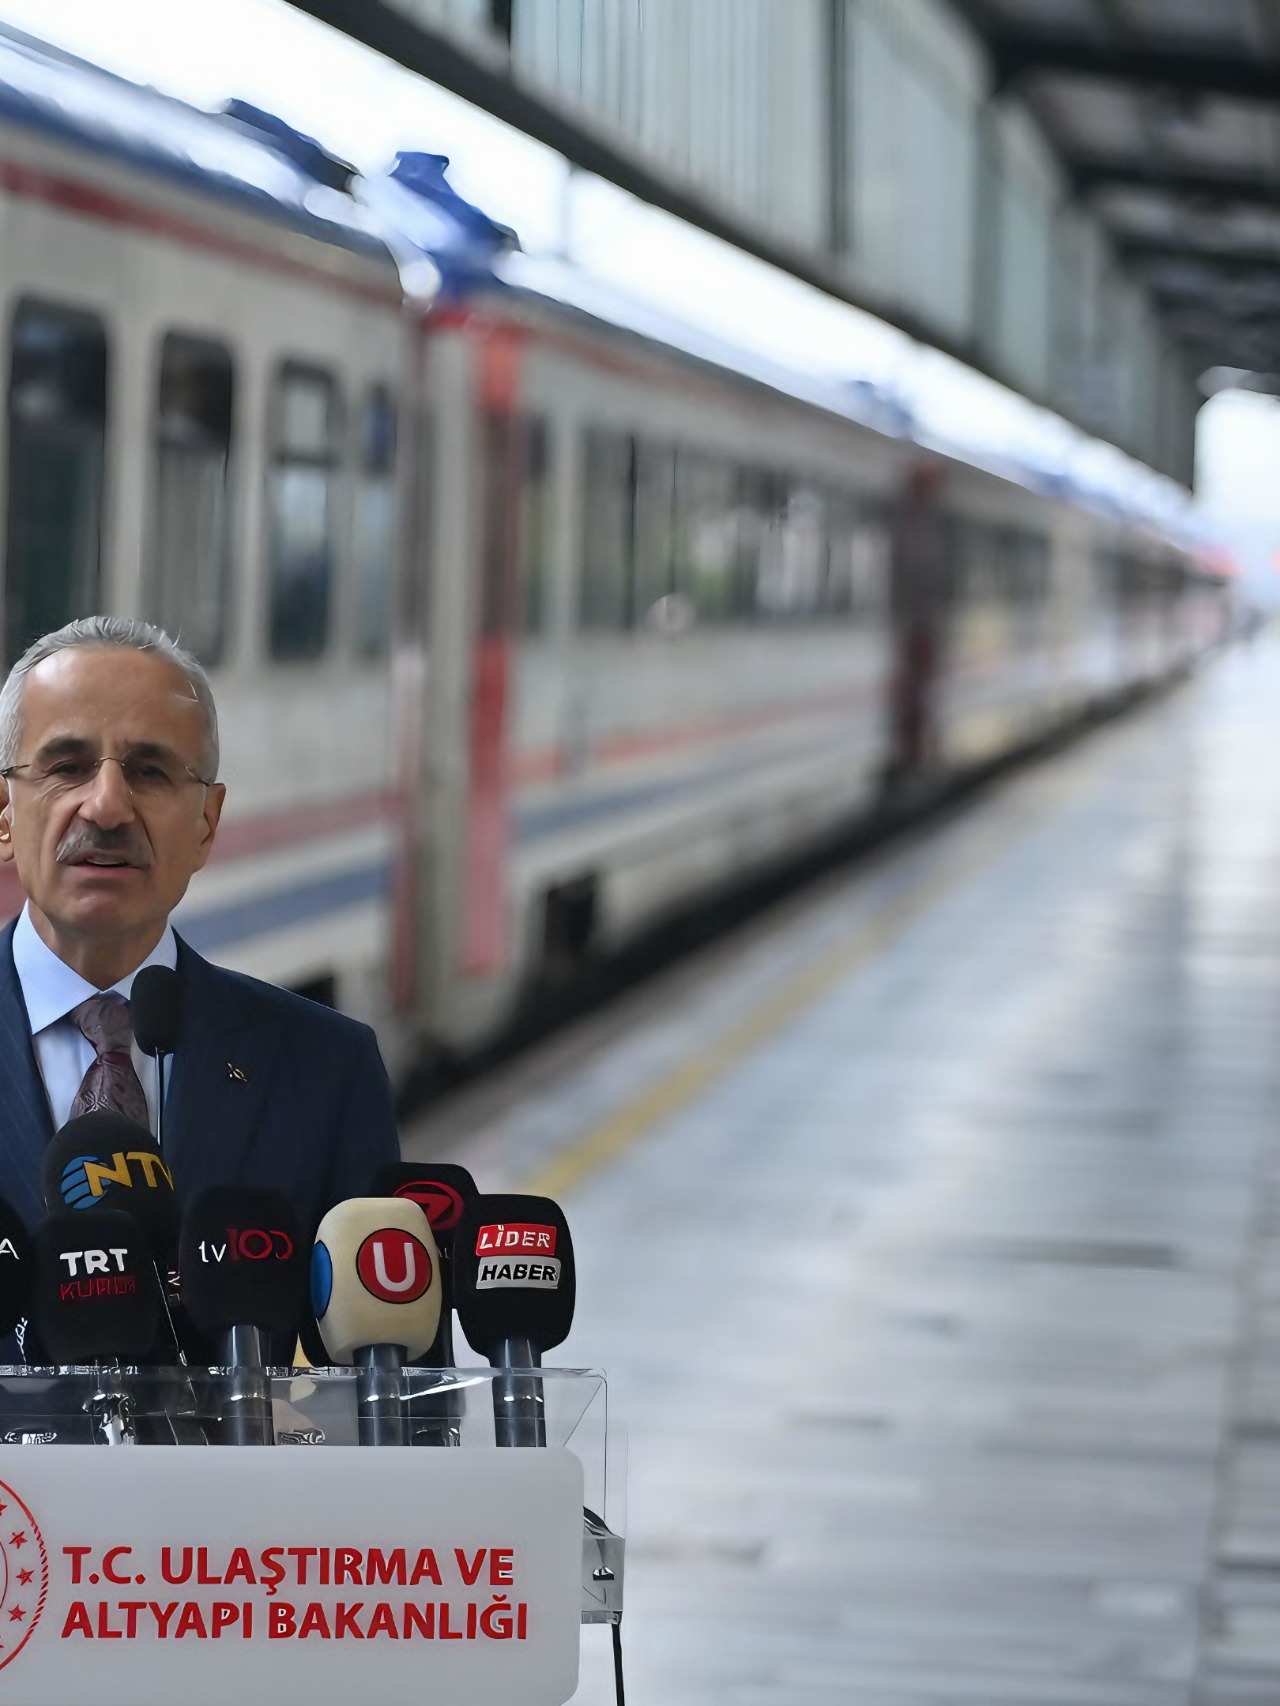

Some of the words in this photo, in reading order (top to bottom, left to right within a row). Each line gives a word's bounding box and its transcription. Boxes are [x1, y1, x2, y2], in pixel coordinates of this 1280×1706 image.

[479, 1224, 550, 1249] LİDER
[59, 1248, 128, 1277] TRT
[372, 1241, 417, 1293] U
[480, 1264, 558, 1282] HABER
[62, 1546, 146, 1585] T.C.
[161, 1547, 443, 1595] ULAŞTIRMA
[453, 1548, 514, 1585] VE
[61, 1601, 252, 1639] ALTYAPI
[268, 1594, 528, 1640] BAKANLIĞI
